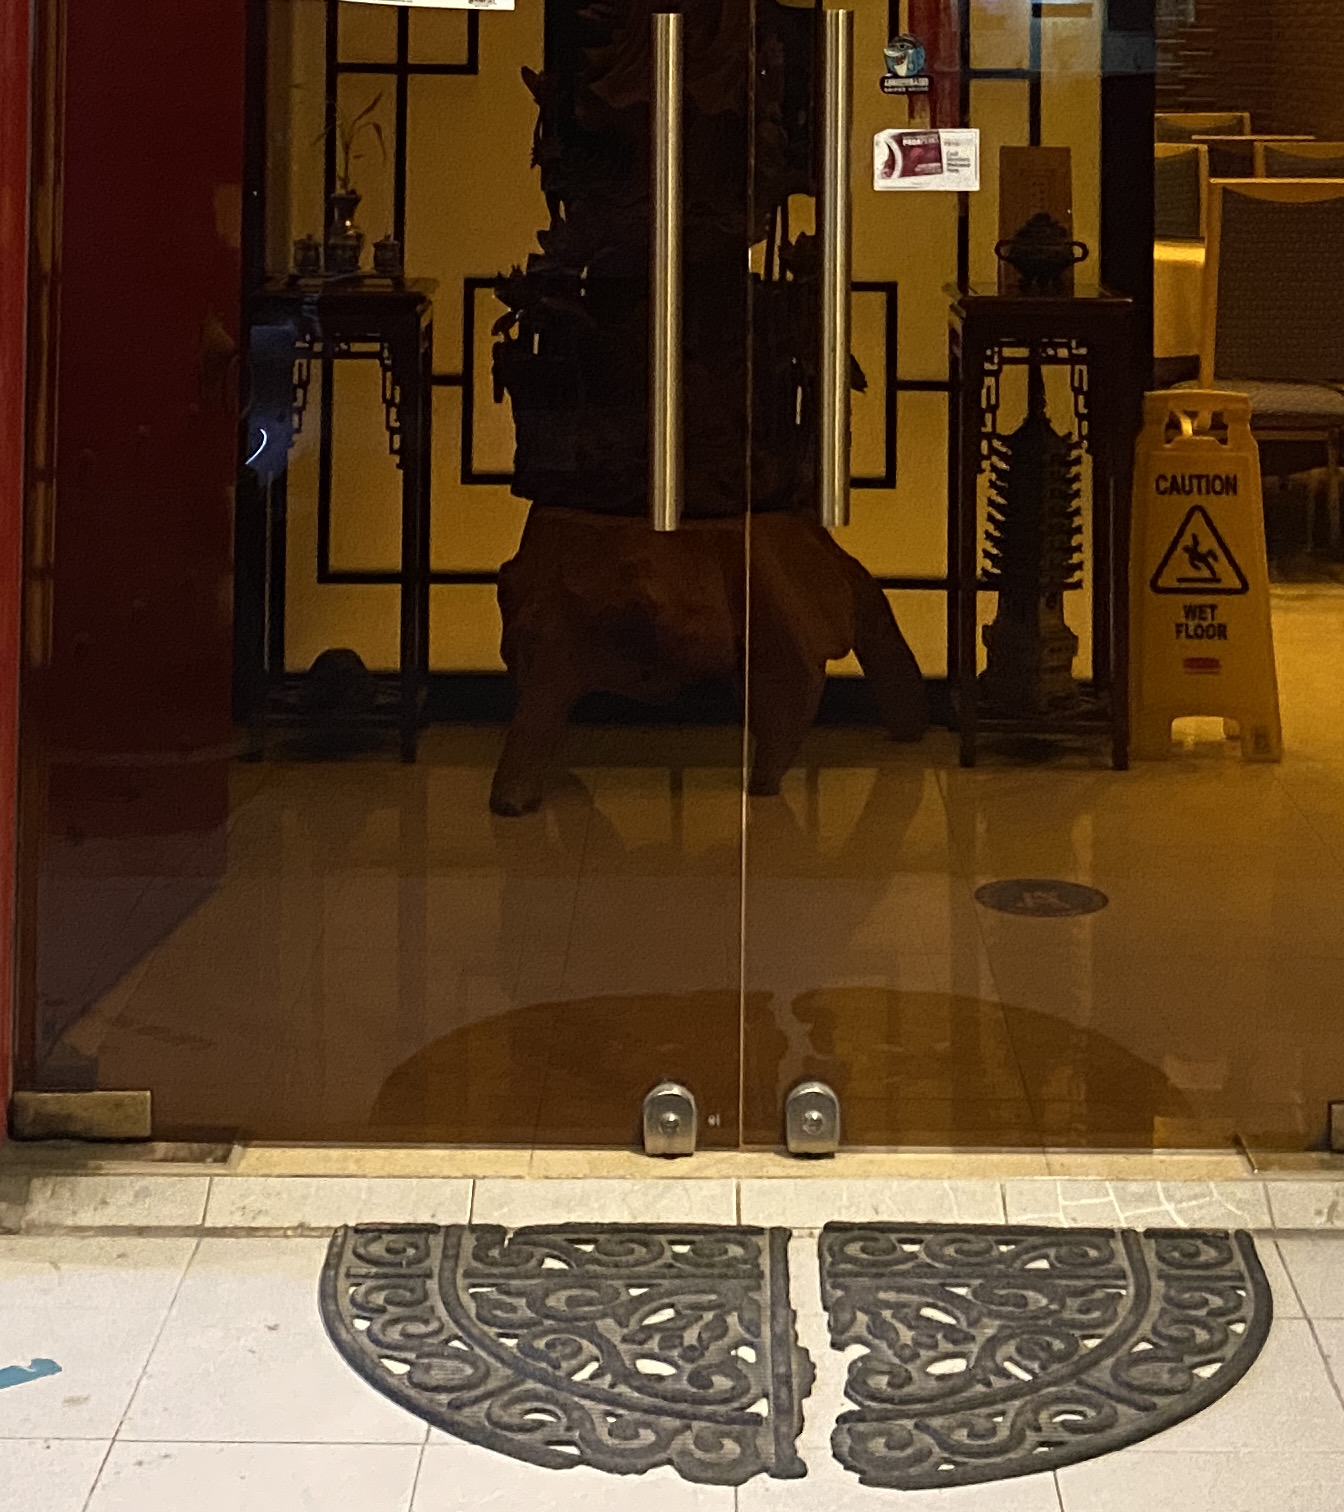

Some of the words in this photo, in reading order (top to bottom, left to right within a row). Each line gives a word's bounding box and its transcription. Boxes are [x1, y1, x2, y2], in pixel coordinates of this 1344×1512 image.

[1155, 473, 1238, 496] CAUTION
[1183, 604, 1218, 621] WET
[1174, 622, 1228, 640] FLOOR
